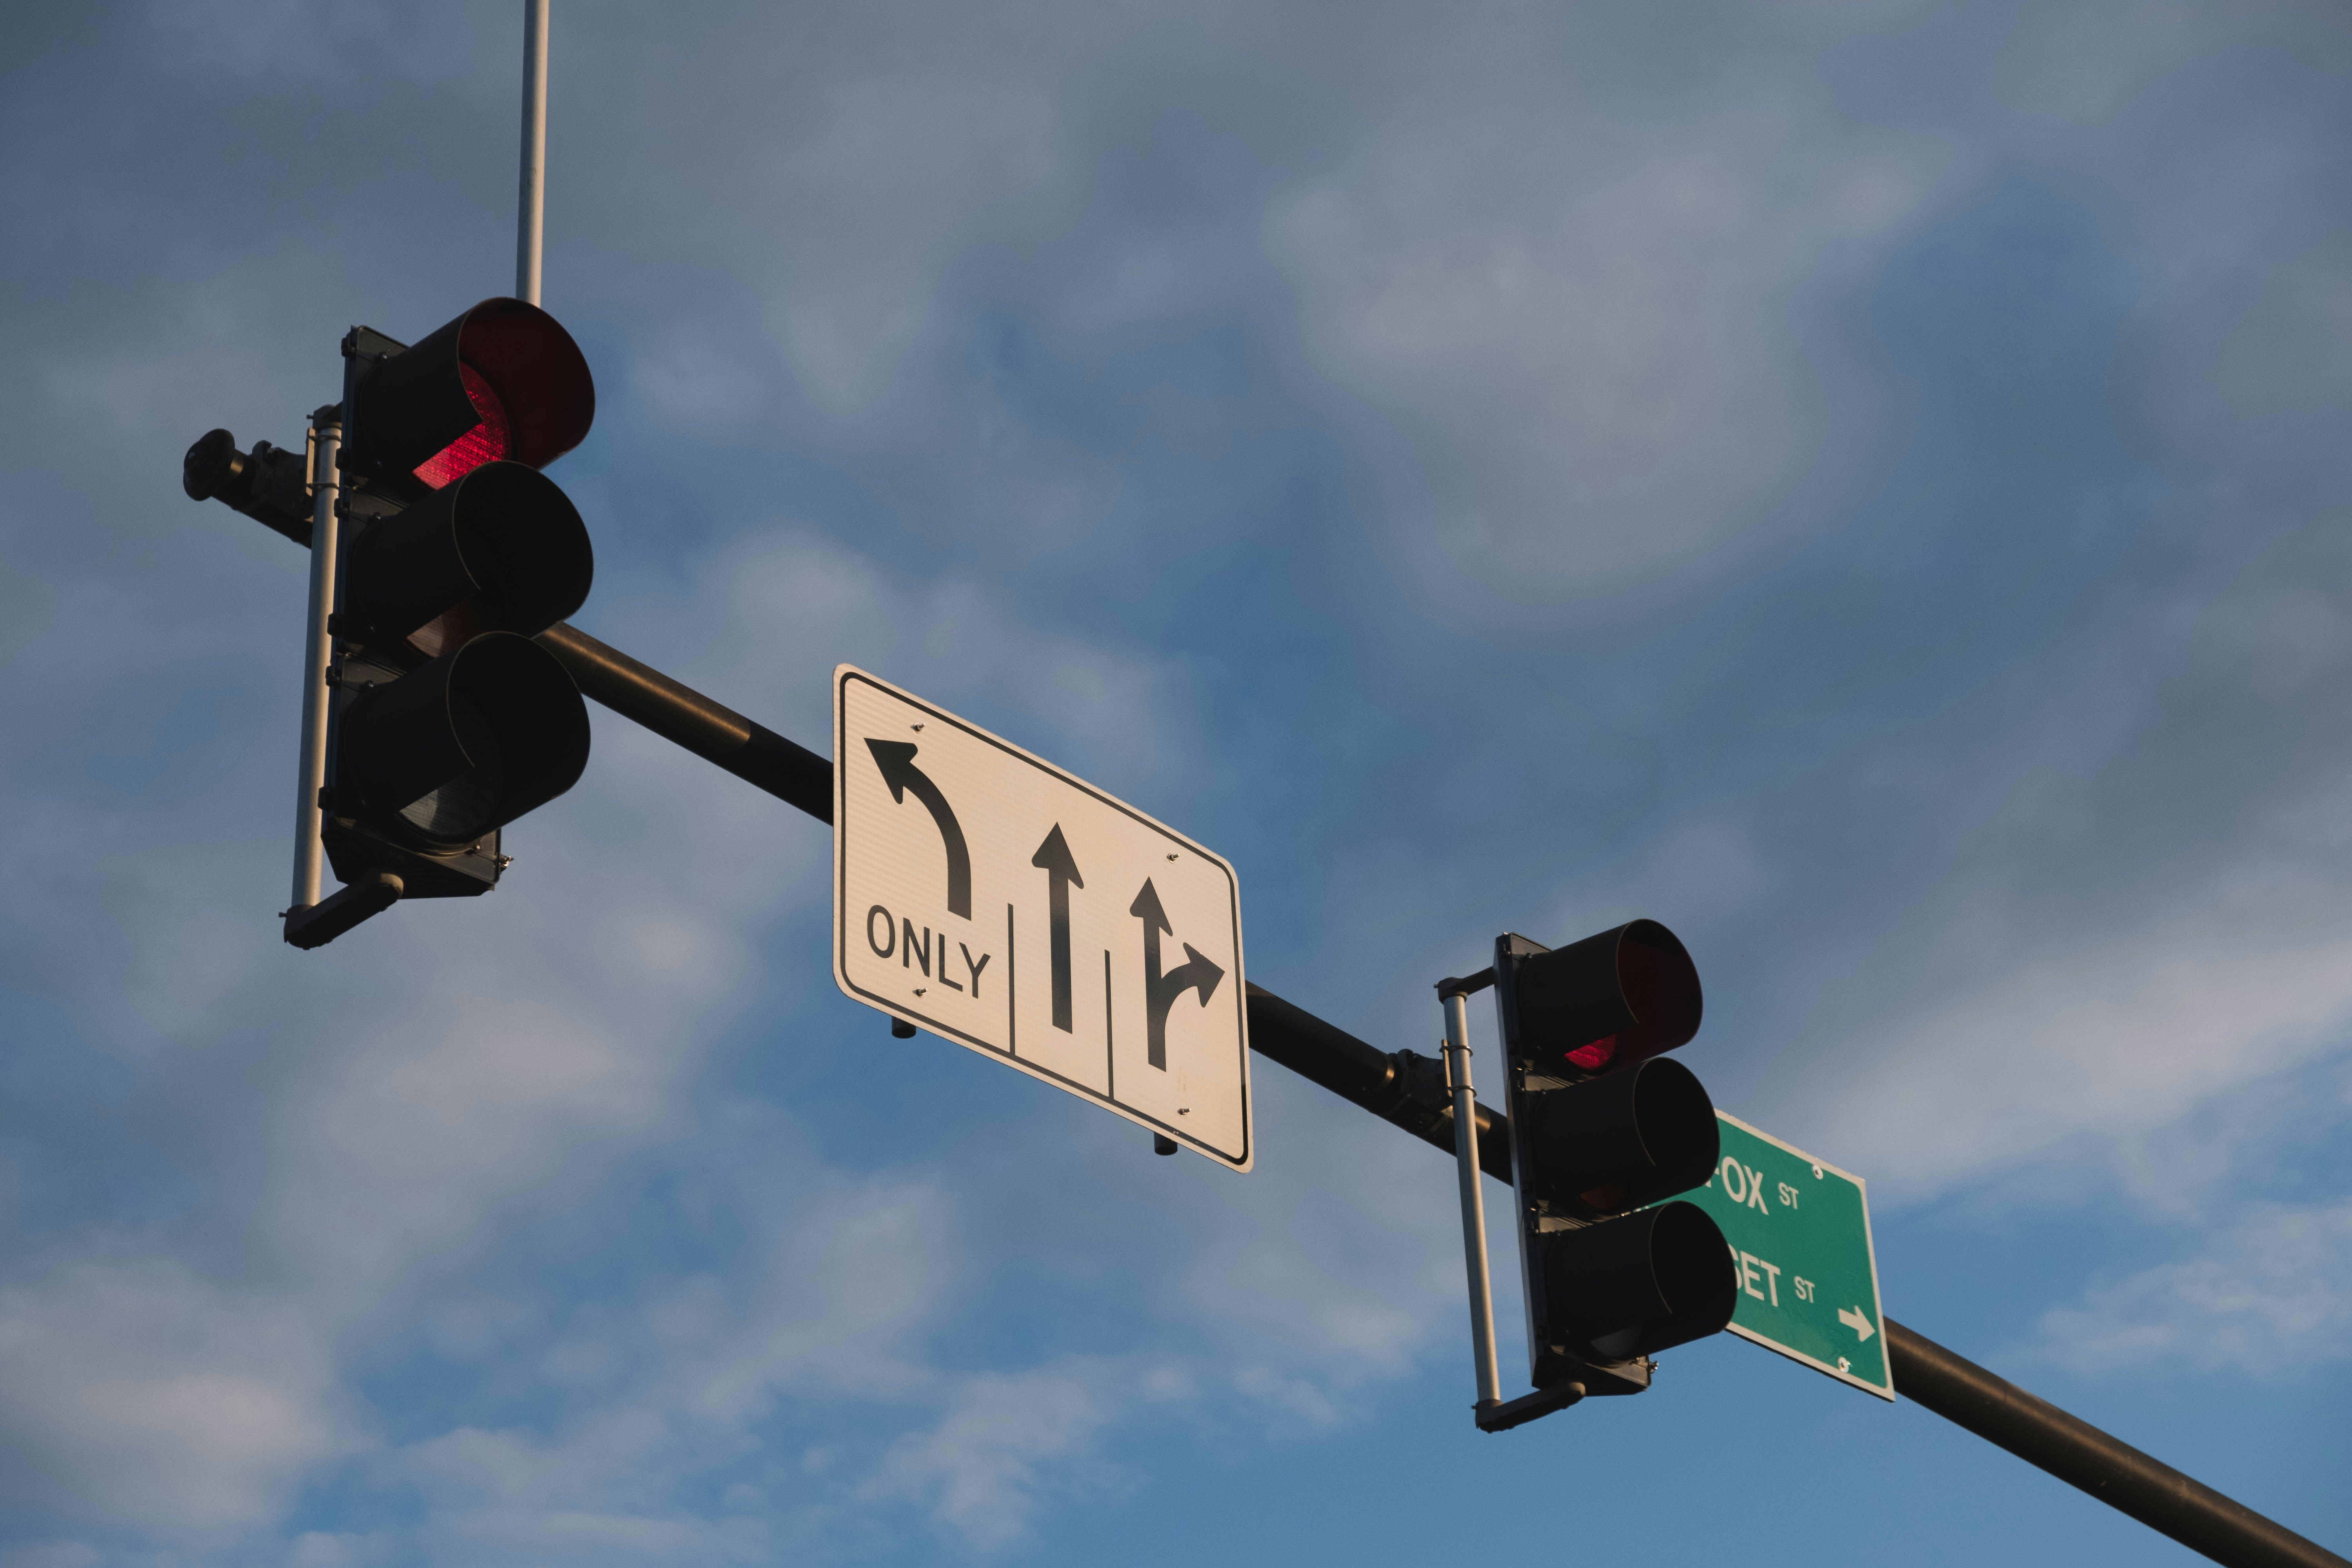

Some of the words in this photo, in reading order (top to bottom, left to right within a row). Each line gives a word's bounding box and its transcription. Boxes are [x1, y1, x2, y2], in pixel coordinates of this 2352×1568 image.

[867, 905, 991, 999] ONLY
[1705, 1156, 1769, 1216] OX
[1778, 1182, 1799, 1209] ST
[1794, 1276, 1815, 1304] ST
